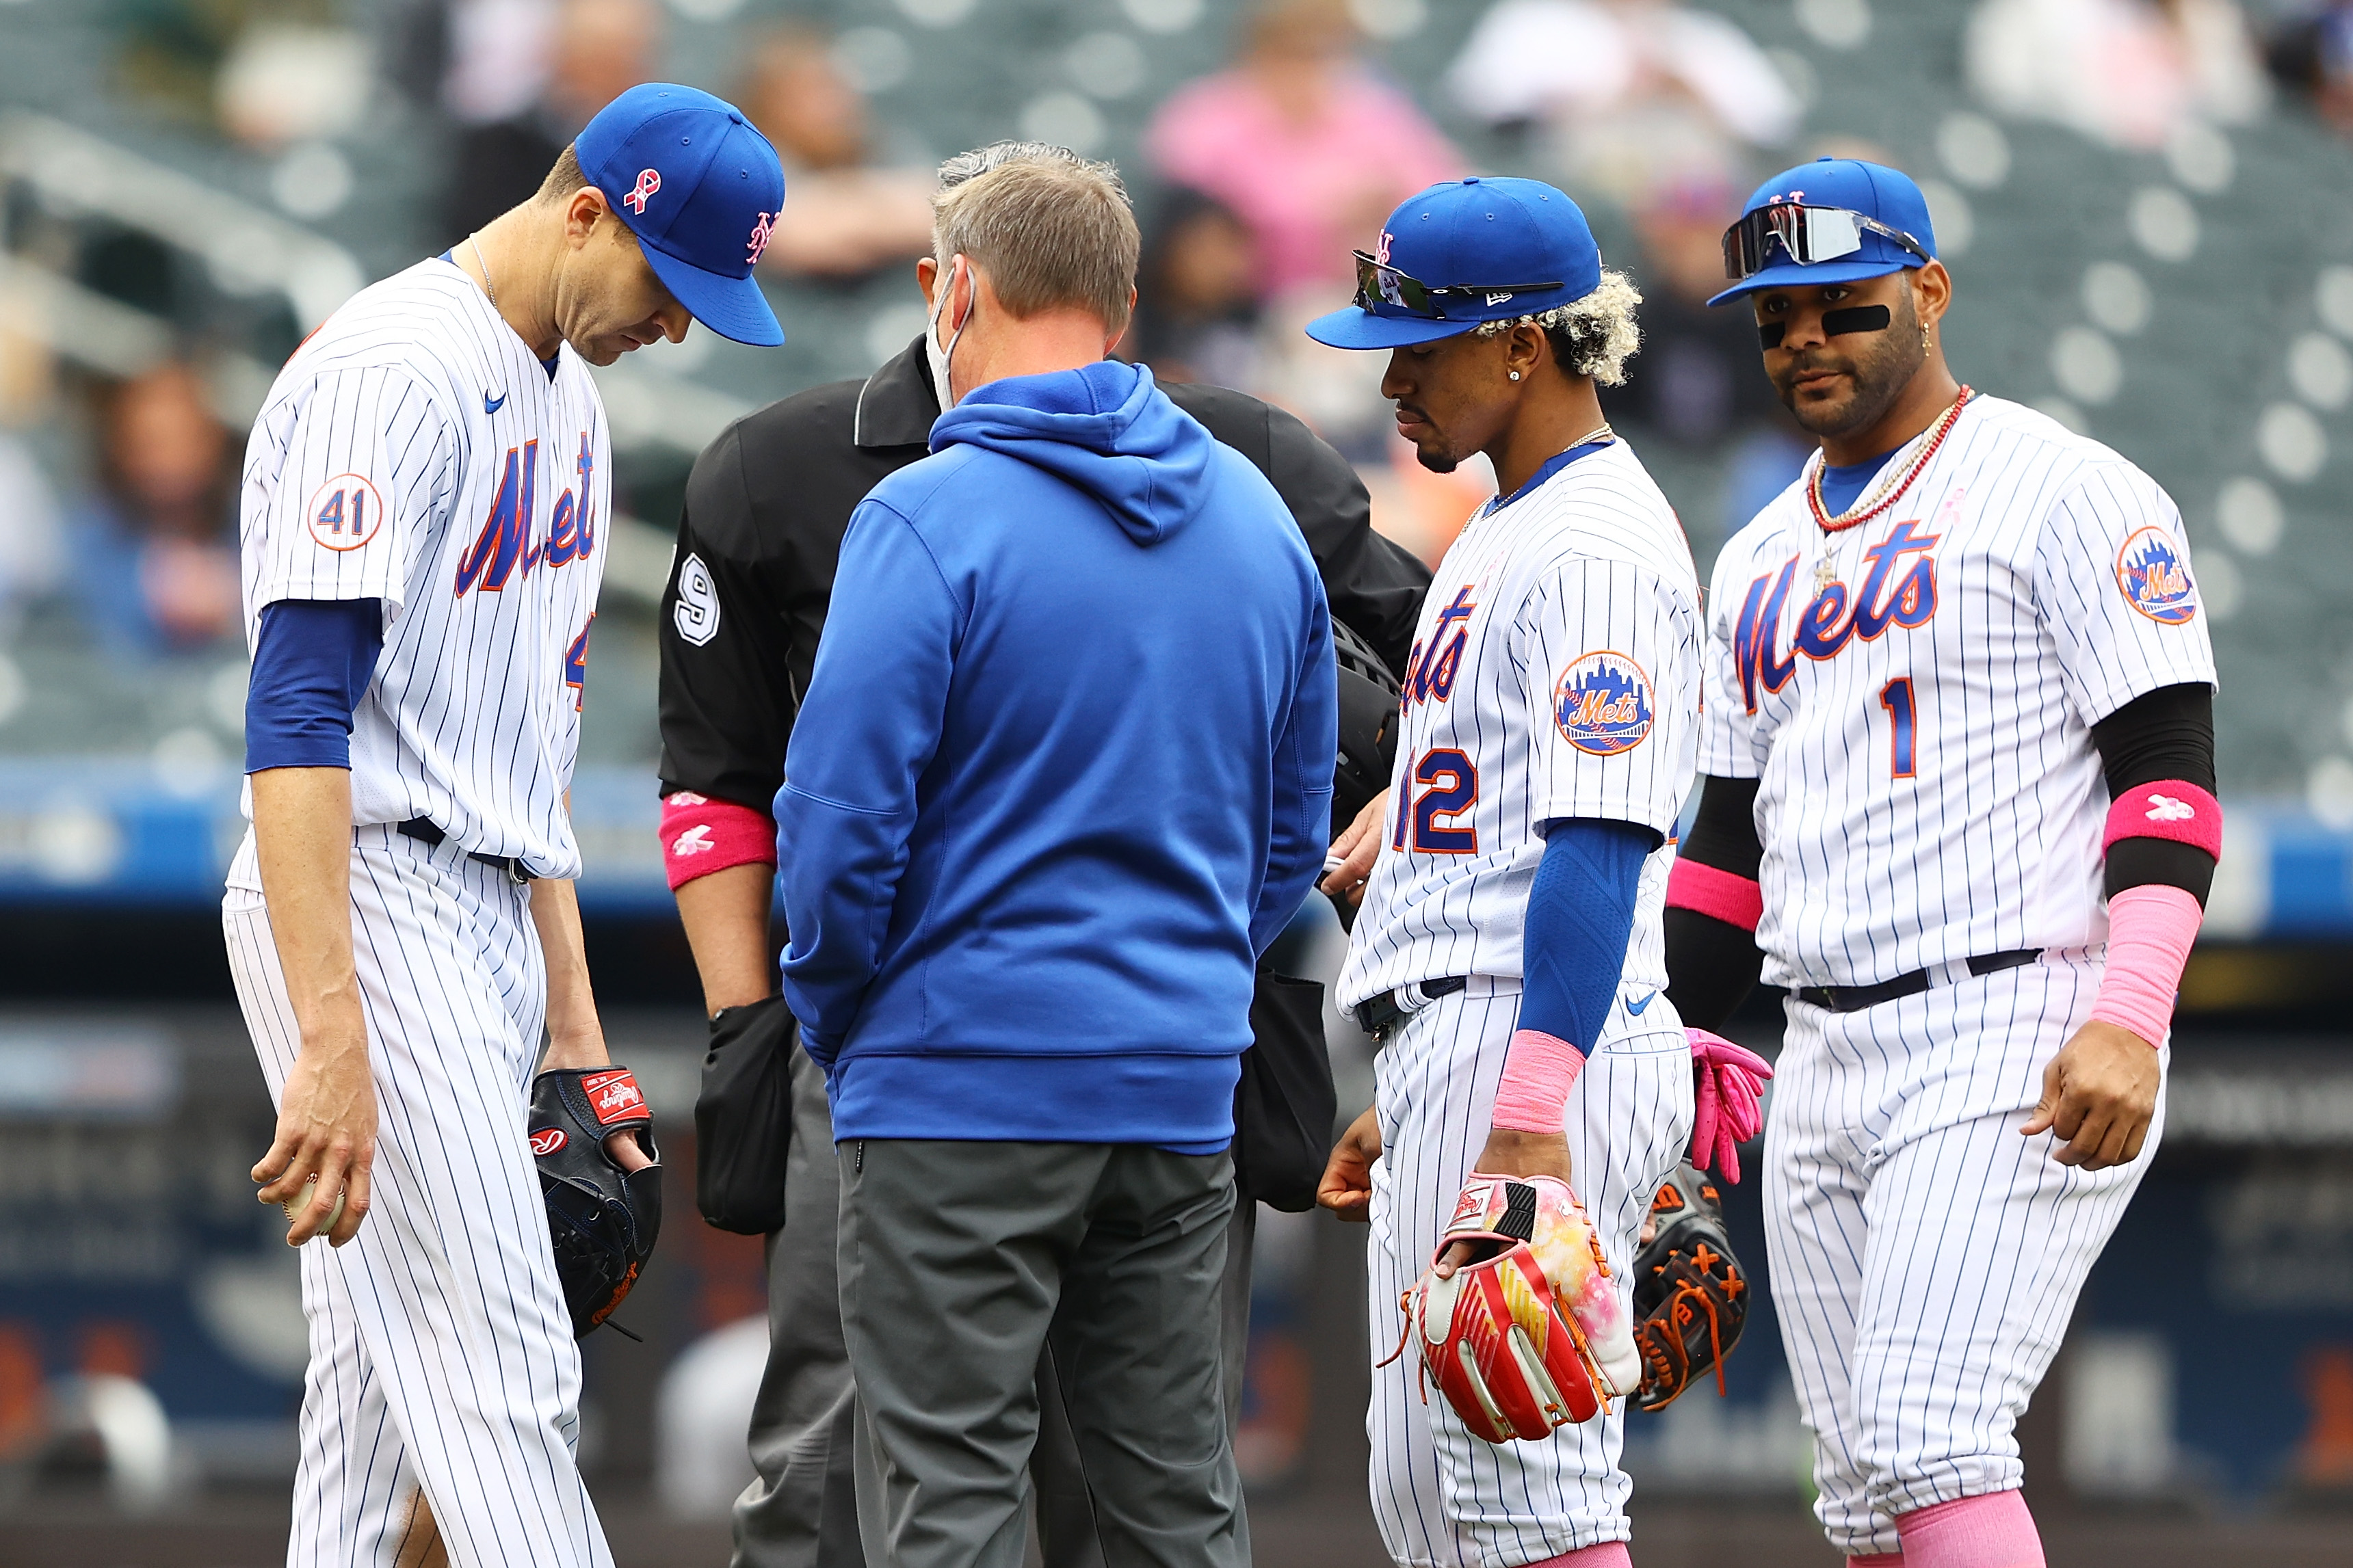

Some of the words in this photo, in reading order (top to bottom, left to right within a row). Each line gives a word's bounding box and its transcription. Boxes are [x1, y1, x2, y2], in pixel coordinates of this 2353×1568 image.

[317, 488, 365, 535] 41
[455, 431, 595, 600] Met
[674, 552, 720, 647] 9
[1735, 519, 1942, 717] Mets
[2140, 561, 2188, 601] Mets
[1568, 689, 1639, 726] Mets
[1879, 677, 1917, 779] 1
[1392, 747, 1478, 854] 12
[599, 1085, 639, 1109] Rawlings
